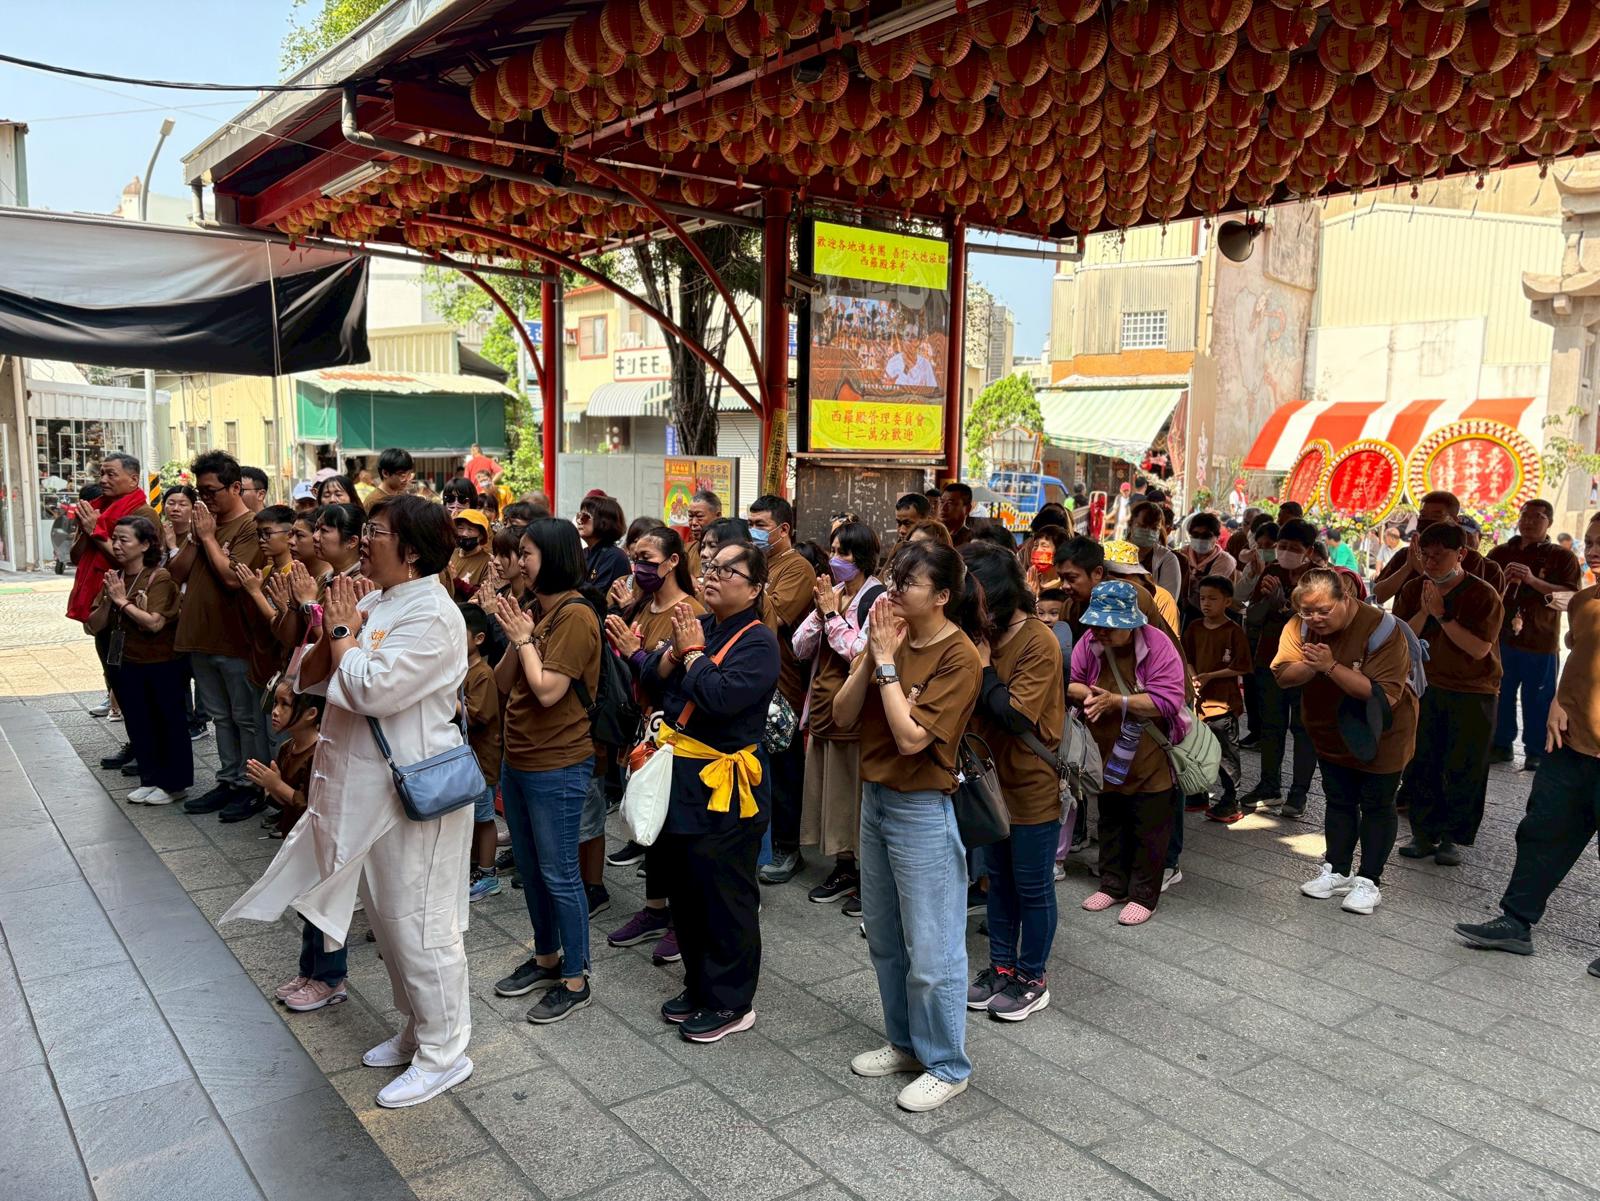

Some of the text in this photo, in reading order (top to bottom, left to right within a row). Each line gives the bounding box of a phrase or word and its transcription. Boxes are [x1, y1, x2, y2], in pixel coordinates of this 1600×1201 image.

[831, 409, 926, 427] 西羅殿管理委員會
[843, 427, 914, 442] 十二萬分歡迎
